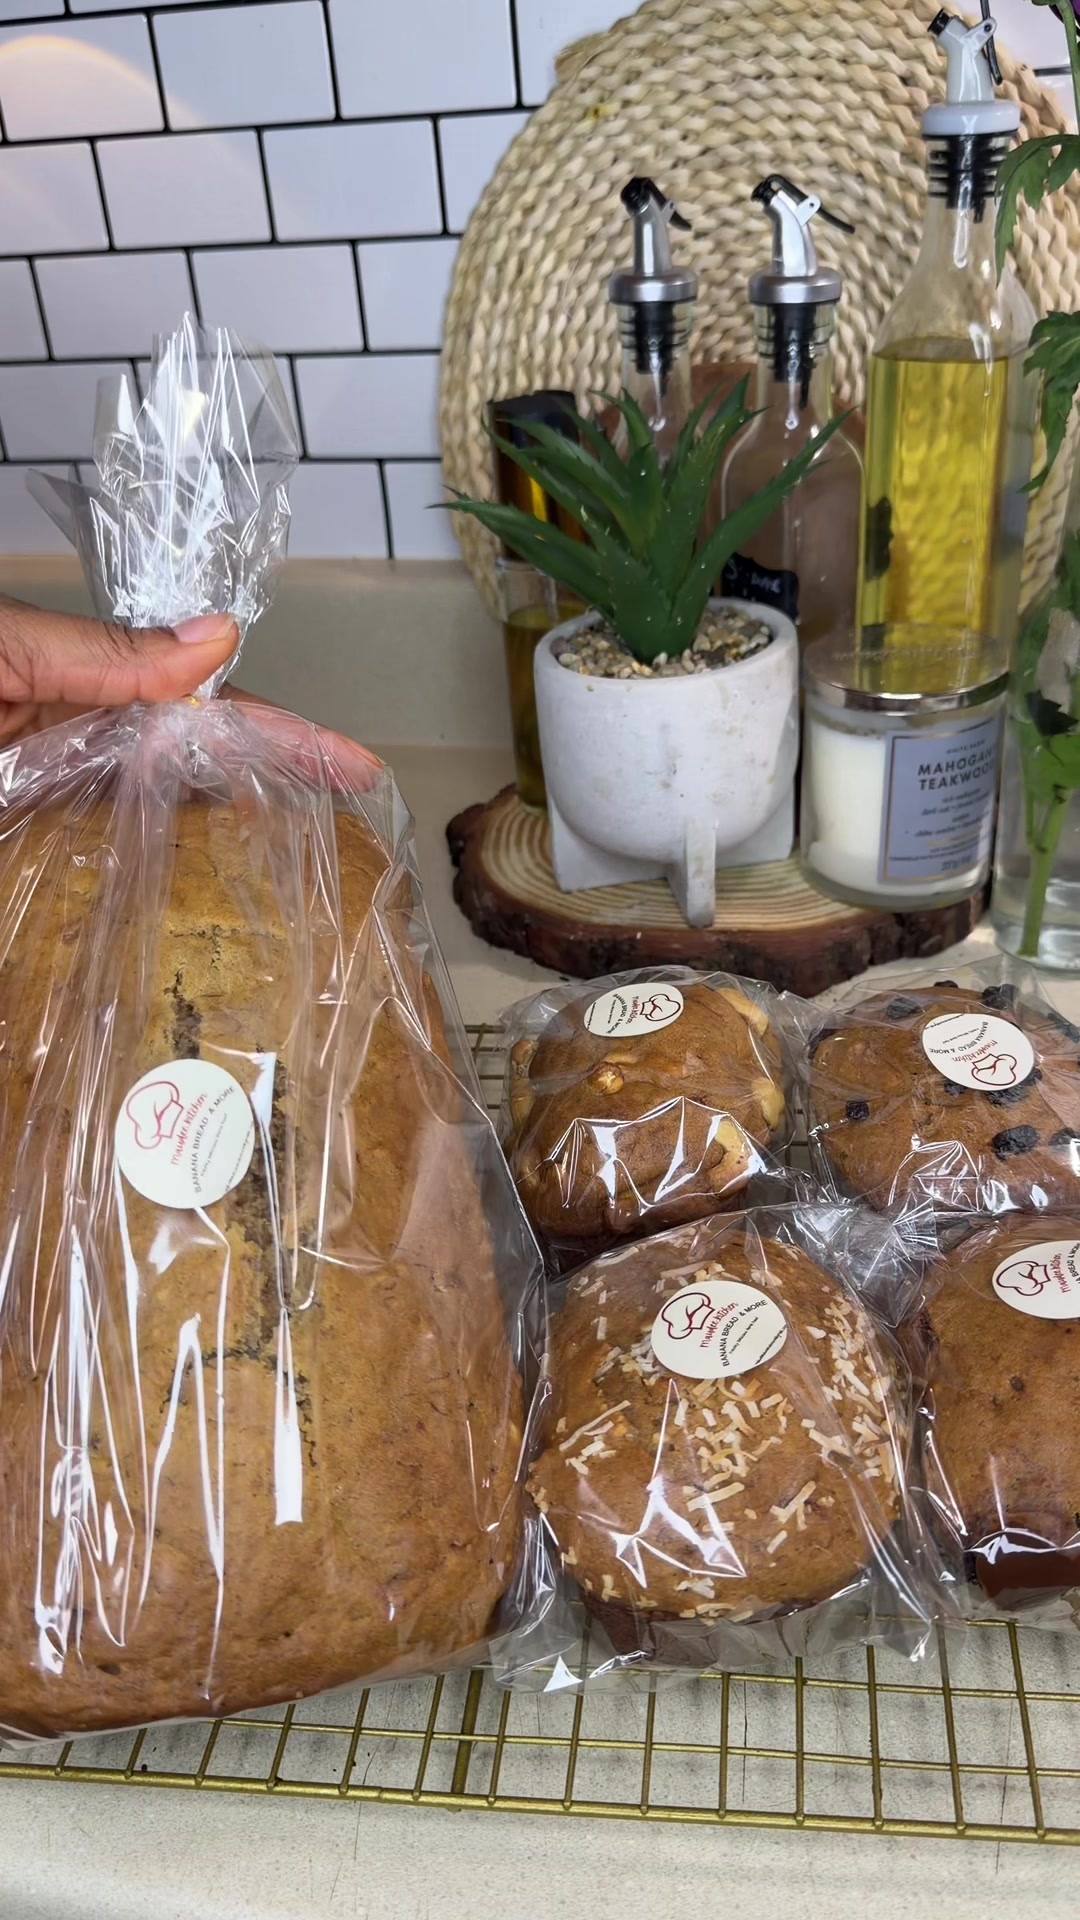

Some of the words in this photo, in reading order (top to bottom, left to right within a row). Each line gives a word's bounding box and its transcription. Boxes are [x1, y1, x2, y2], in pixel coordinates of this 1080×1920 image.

[192, 1117, 210, 1149] BREAD
[744, 1299, 768, 1313] MORE
[721, 1316, 739, 1337] BREAD
[719, 1336, 731, 1367] BANANA
